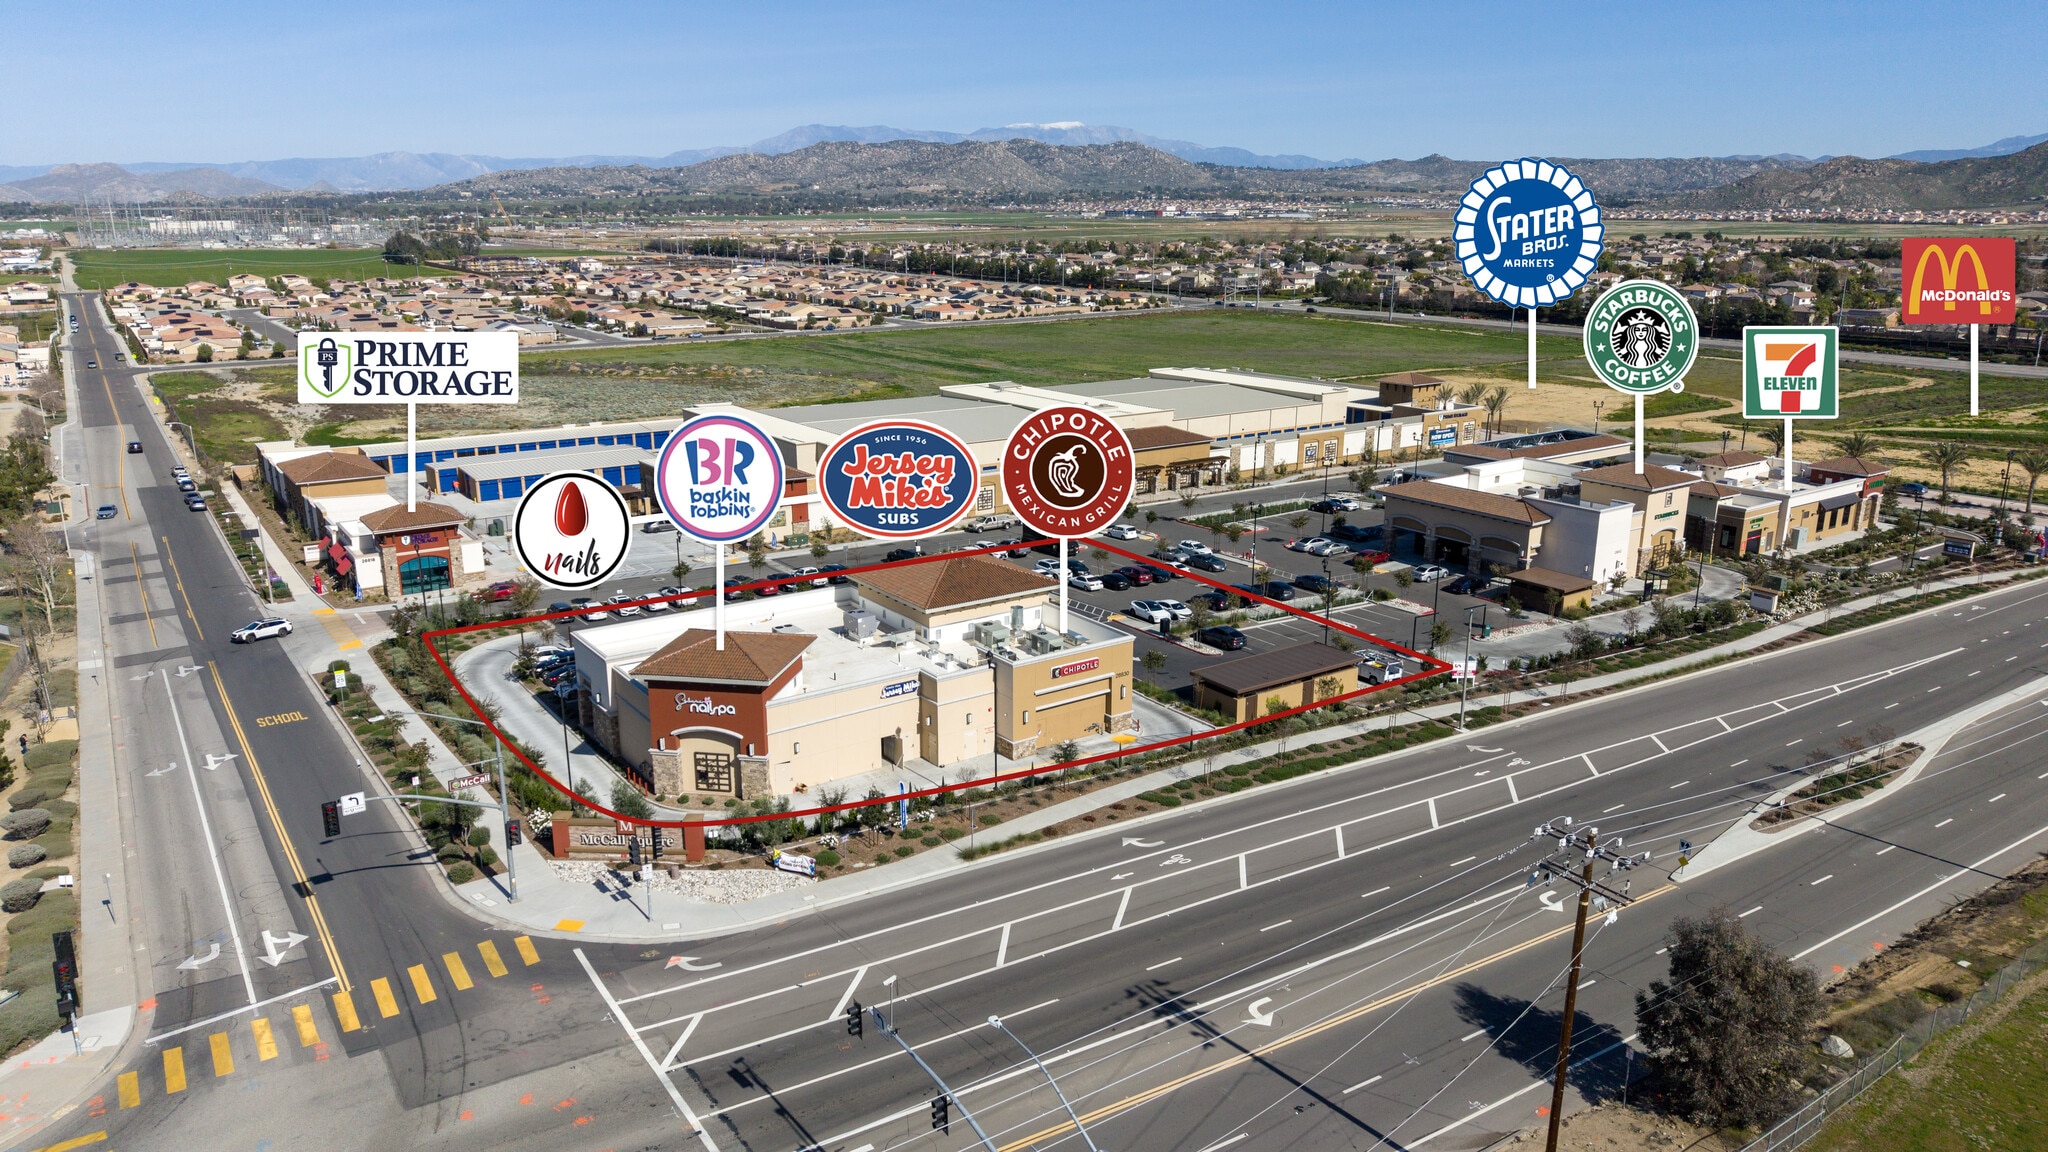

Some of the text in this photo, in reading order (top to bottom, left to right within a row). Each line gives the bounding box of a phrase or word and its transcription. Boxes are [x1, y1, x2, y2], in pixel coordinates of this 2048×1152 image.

[1063, 661, 1099, 675] CHIPOTLE
[256, 711, 308, 728] SCHOOL
[460, 774, 490, 788] McCall
[620, 820, 633, 832] M
[580, 834, 675, 848] McCall Squre
